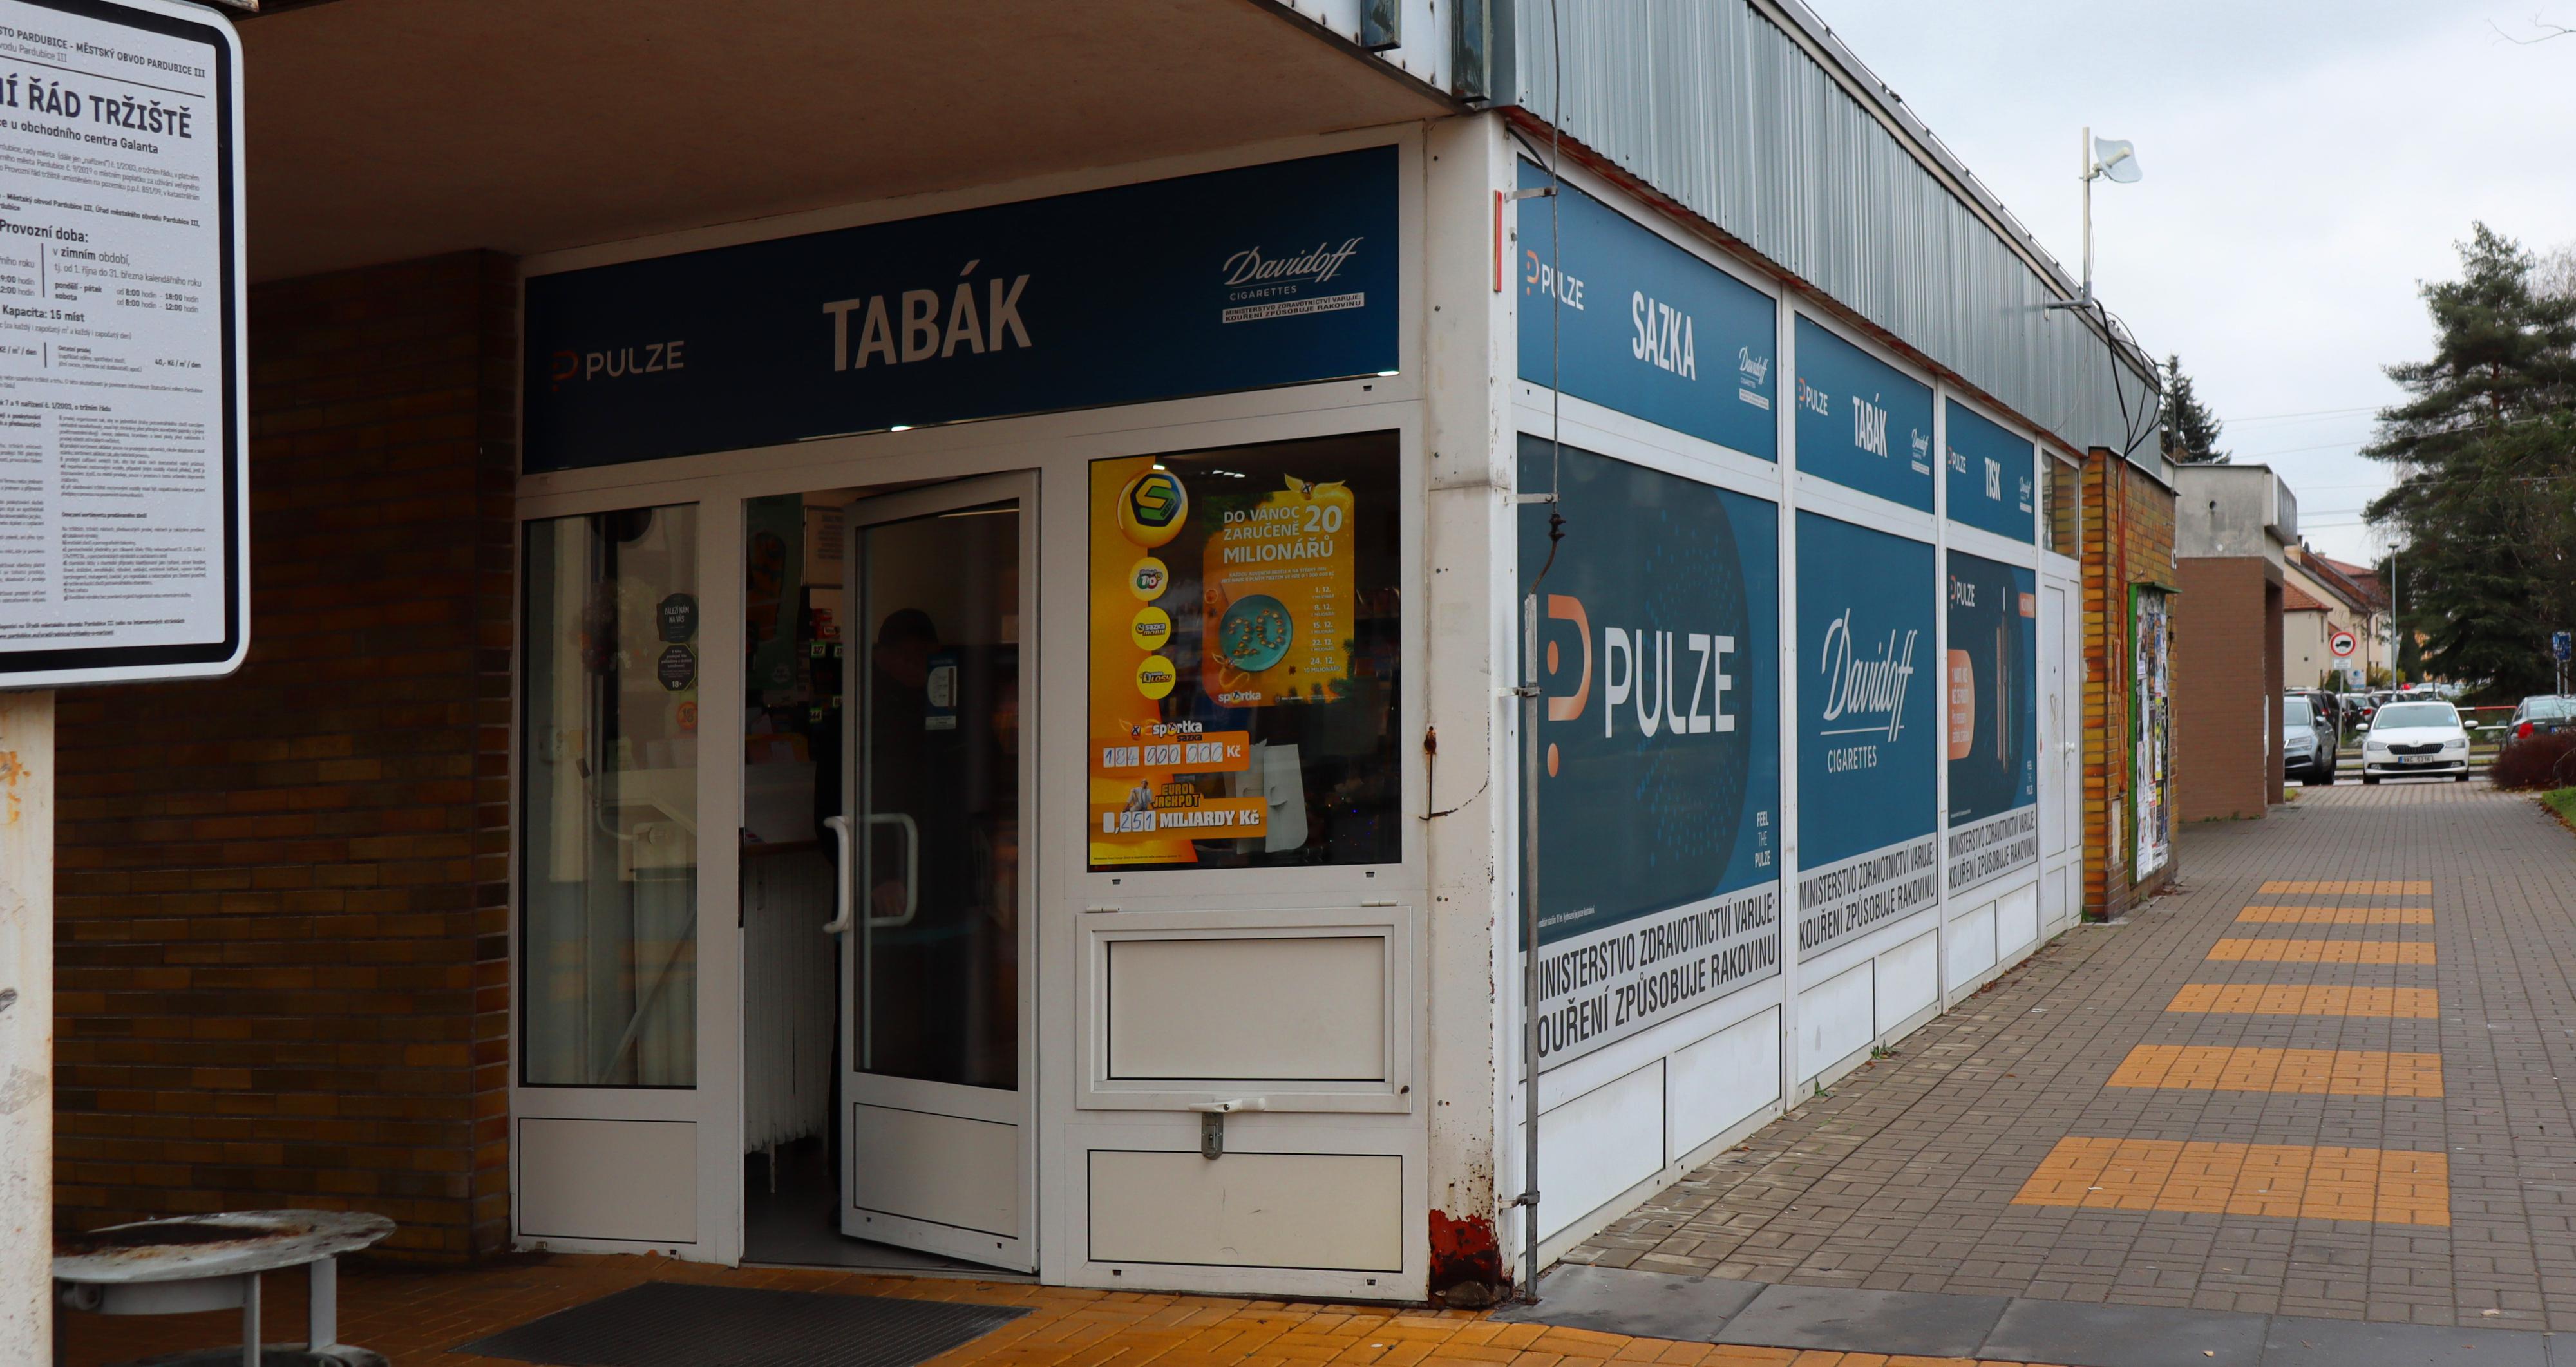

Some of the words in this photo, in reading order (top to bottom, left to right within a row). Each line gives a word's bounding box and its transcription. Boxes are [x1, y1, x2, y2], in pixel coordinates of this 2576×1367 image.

[17, 30, 68, 49] PARDUBICE
[76, 41, 115, 59] MĚSTSKÝ
[117, 51, 146, 65] OBVOD
[147, 57, 192, 75] PARDUBICE
[194, 67, 205, 78] III
[19, 44, 55, 60] Pardubice
[57, 52, 67, 62] III
[29, 76, 81, 118] ŘÁD
[89, 95, 192, 139] TRŽIŠTĚ
[12, 120, 17, 129] u
[21, 121, 81, 141] obchodního
[84, 133, 117, 147] centra
[120, 138, 158, 155] Galanta
[37, 159, 64, 170] Pardubice
[34, 198, 52, 206] obvod
[53, 200, 82, 211] Pardubice
[163, 216, 189, 225] Pardubice
[0, 219, 53, 238] Provozní
[56, 227, 88, 243] doba:
[19, 259, 35, 269] roku
[61, 247, 96, 261] zimním
[99, 251, 131, 267] období,
[1223, 237, 1364, 285] Davidoff
[55, 281, 79, 291] pondělí
[84, 284, 103, 294] pátek
[64, 264, 73, 272] od
[99, 268, 108, 277] do
[121, 270, 144, 281] března
[145, 273, 186, 287] kalendářního
[187, 278, 202, 287] roku
[1542, 263, 1584, 311] PULZE
[18, 288, 35, 296] hodin
[55, 292, 77, 301] sobota
[126, 288, 140, 297] 8:00
[141, 290, 157, 299] hodin
[166, 293, 182, 301] 18:00
[184, 295, 199, 303] hodin
[1230, 285, 1297, 301] CIGARETTES
[3, 305, 48, 319] Kapacita:
[50, 309, 62, 319] 15
[64, 311, 85, 322] míst
[126, 299, 140, 308] 8:00
[141, 301, 157, 309] hodin
[166, 303, 182, 312] 12:00
[184, 305, 199, 314] hodin
[822, 259, 1032, 372] TABÁK
[1226, 304, 1276, 316] MINISTERSTVO
[1278, 297, 1331, 309] ZDRAVOTNICTVÍ
[1226, 311, 1262, 321] KOUŘENÍ
[1265, 305, 1314, 317] ZPŮSOBUJE
[1318, 300, 1361, 310] RAKOVINU
[1632, 290, 1696, 381] SAZKA
[586, 340, 685, 380] PULZE
[1739, 345, 1768, 386] Davidoff
[1806, 385, 1828, 417] PULZE
[1852, 393, 1888, 458] TABÁK
[1952, 455, 1967, 474] PULZE
[1985, 457, 2001, 501] TISK
[1224, 509, 1245, 524] DO
[1249, 502, 1300, 522] VÁNOC
[1224, 520, 1300, 541] ZARUČENĚ
[1303, 505, 1343, 533] 20
[1224, 535, 1334, 563] MILIONÁŘŮ
[1956, 582, 1975, 607] PULZE
[1605, 627, 1735, 739] PULZE
[1821, 608, 1918, 742] Davidoff
[1153, 721, 1203, 738] sportka
[1227, 744, 1242, 759] Kč
[1828, 745, 1877, 773] CIGARETTES
[1154, 793, 1202, 808] JACKPOT
[1160, 811, 1236, 829] MILIARDY
[1239, 809, 1260, 825] Kč
[1756, 811, 1769, 827] FEEL
[1757, 830, 1768, 847] THE
[1949, 826, 1984, 860] MINISTERSTVO
[1985, 811, 2018, 845] ZDRAVOTNICTVÍ
[1755, 849, 1771, 868] PULZE
[1949, 854, 1976, 890] KOUŘENÍ
[1978, 845, 2009, 878] ZPŮSOBUJE
[2011, 836, 2035, 864] RAKOVINU
[1799, 865, 1857, 911] MINISTERSTVO
[1859, 844, 1909, 891] ZDRAVOTNICTVÍ
[1910, 841, 1935, 871] VARUJE:
[1799, 902, 1842, 952] KOUŘENÍ
[1846, 888, 1895, 932] ZPŮSOBUJE
[1898, 873, 1935, 911] RAKOVINU
[1640, 897, 1731, 966] ZDRAVOTNICTVÍ
[1734, 892, 1776, 932] VARUJE:
[1615, 958, 1706, 1026] ZPŮSOBUJE
[1711, 933, 1776, 988] RAKOVINU
